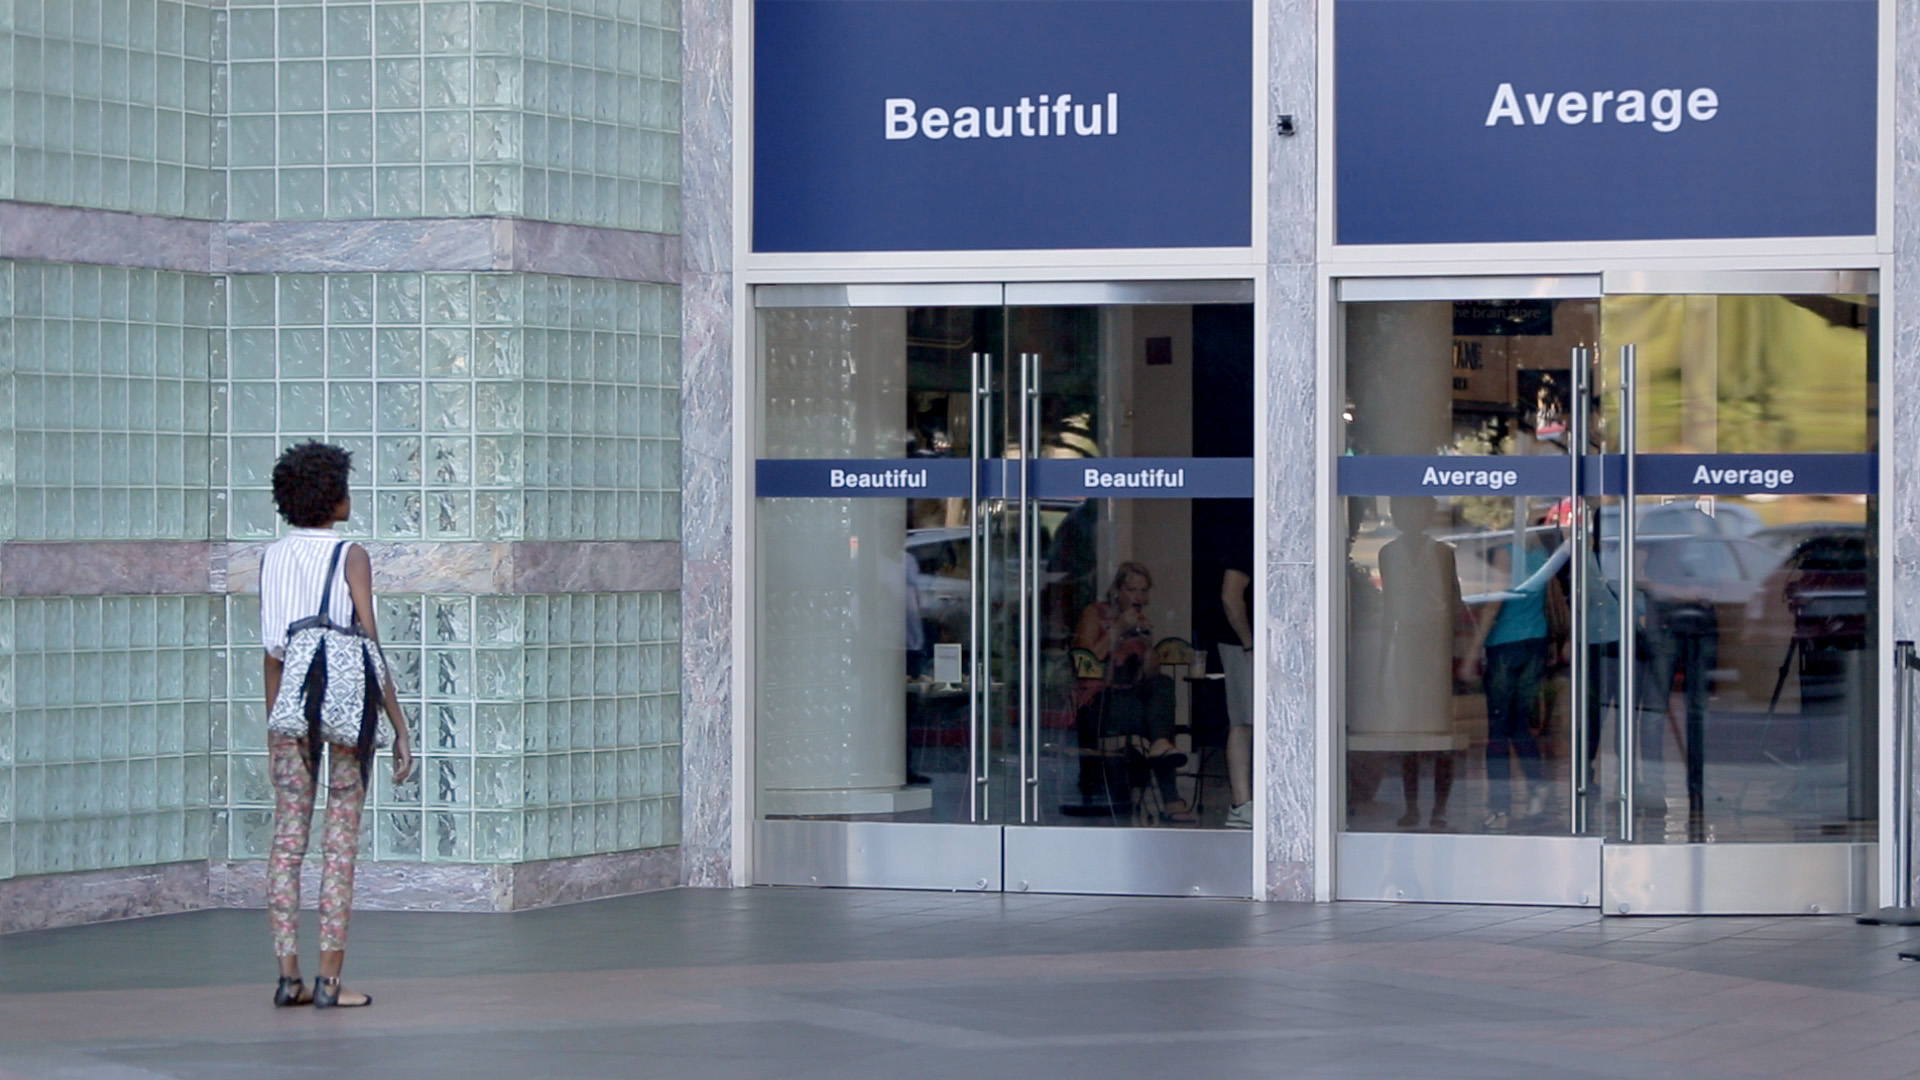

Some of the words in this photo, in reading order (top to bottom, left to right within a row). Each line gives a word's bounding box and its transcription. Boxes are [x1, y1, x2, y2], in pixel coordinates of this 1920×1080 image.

[884, 93, 1119, 140] Beautiful
[1485, 83, 1719, 132] Average
[830, 470, 928, 489] Beautiful
[1084, 469, 1184, 489] Beautiful
[1421, 467, 1518, 490] Average
[1692, 465, 1794, 489] Average
